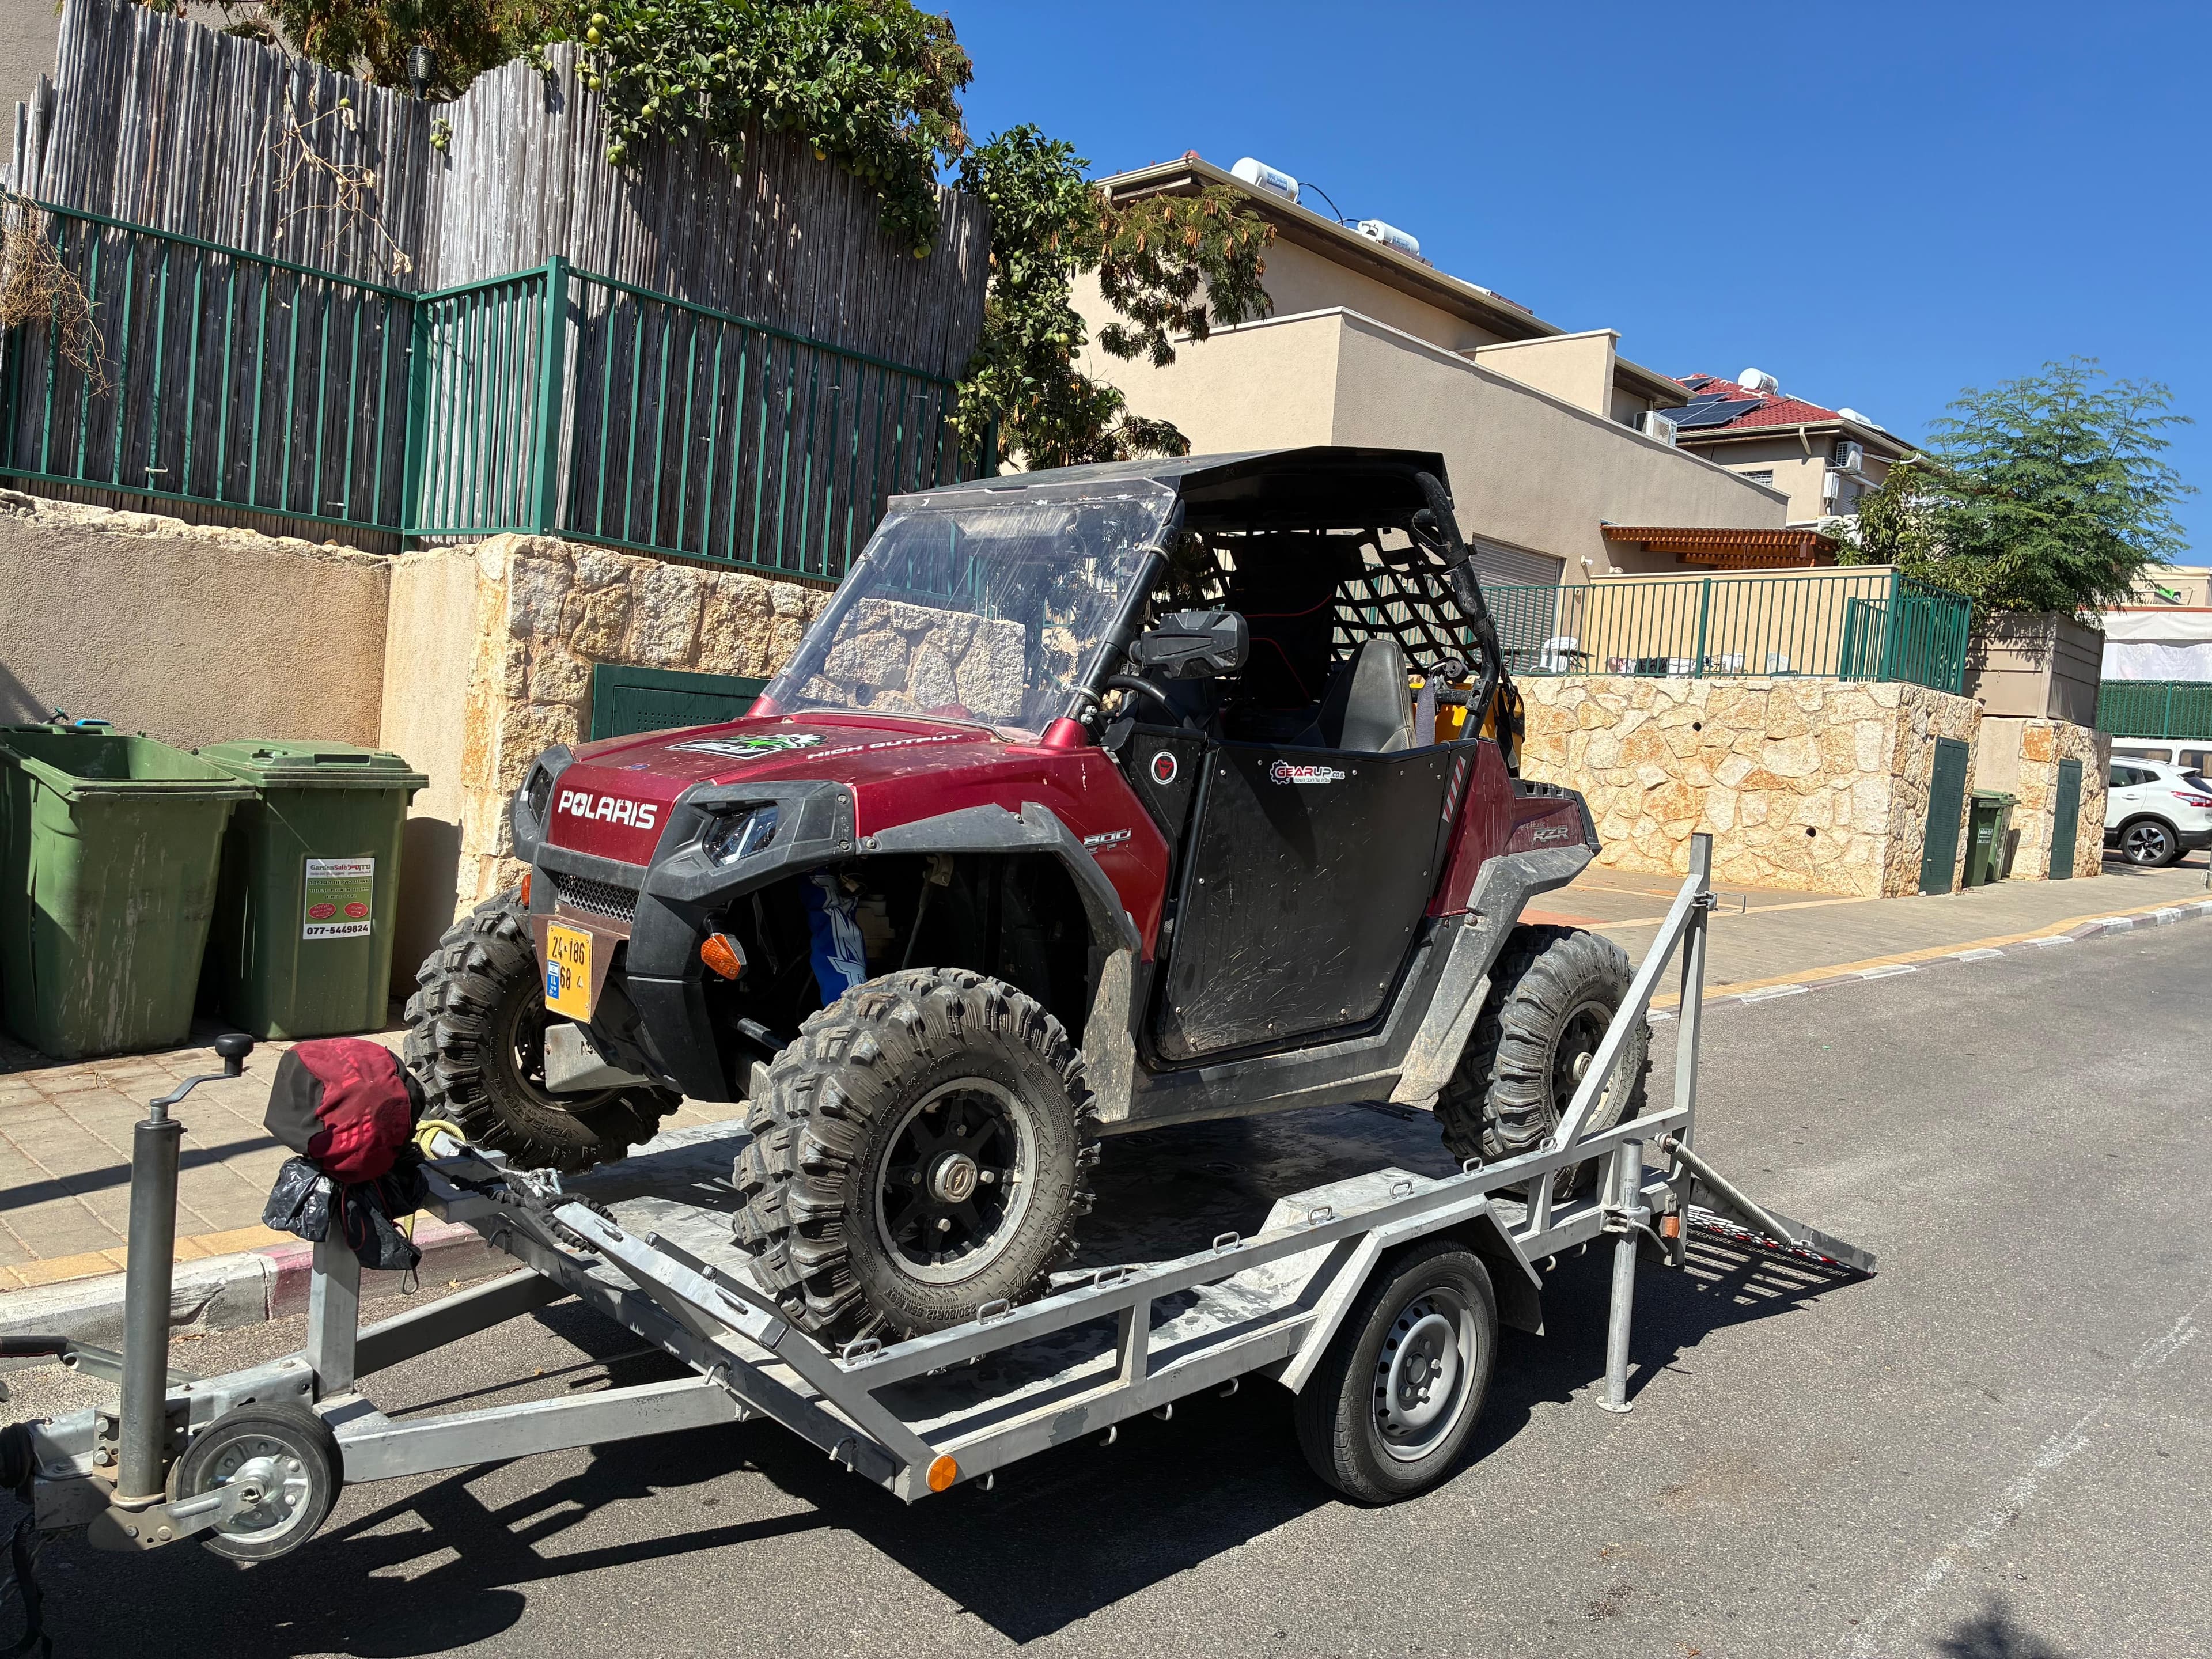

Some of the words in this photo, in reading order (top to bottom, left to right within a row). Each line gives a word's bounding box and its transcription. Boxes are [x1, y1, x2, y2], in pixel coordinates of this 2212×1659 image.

[808, 745, 863, 760] HIGH
[870, 733, 963, 749] OUTPUT
[557, 790, 658, 830] POLARIS
[1083, 828, 1132, 847] 800
[1532, 824, 1569, 842] RZR
[306, 924, 369, 935] 077-5449824
[560, 965, 571, 991] 68
[1037, 1215, 1048, 1236] MADE
[998, 1183, 1071, 1300] CARLSTAR
[1033, 1235, 1039, 1244] IN
[1018, 1244, 1034, 1263] CHINA
[926, 1302, 977, 1321] 230/80R12
